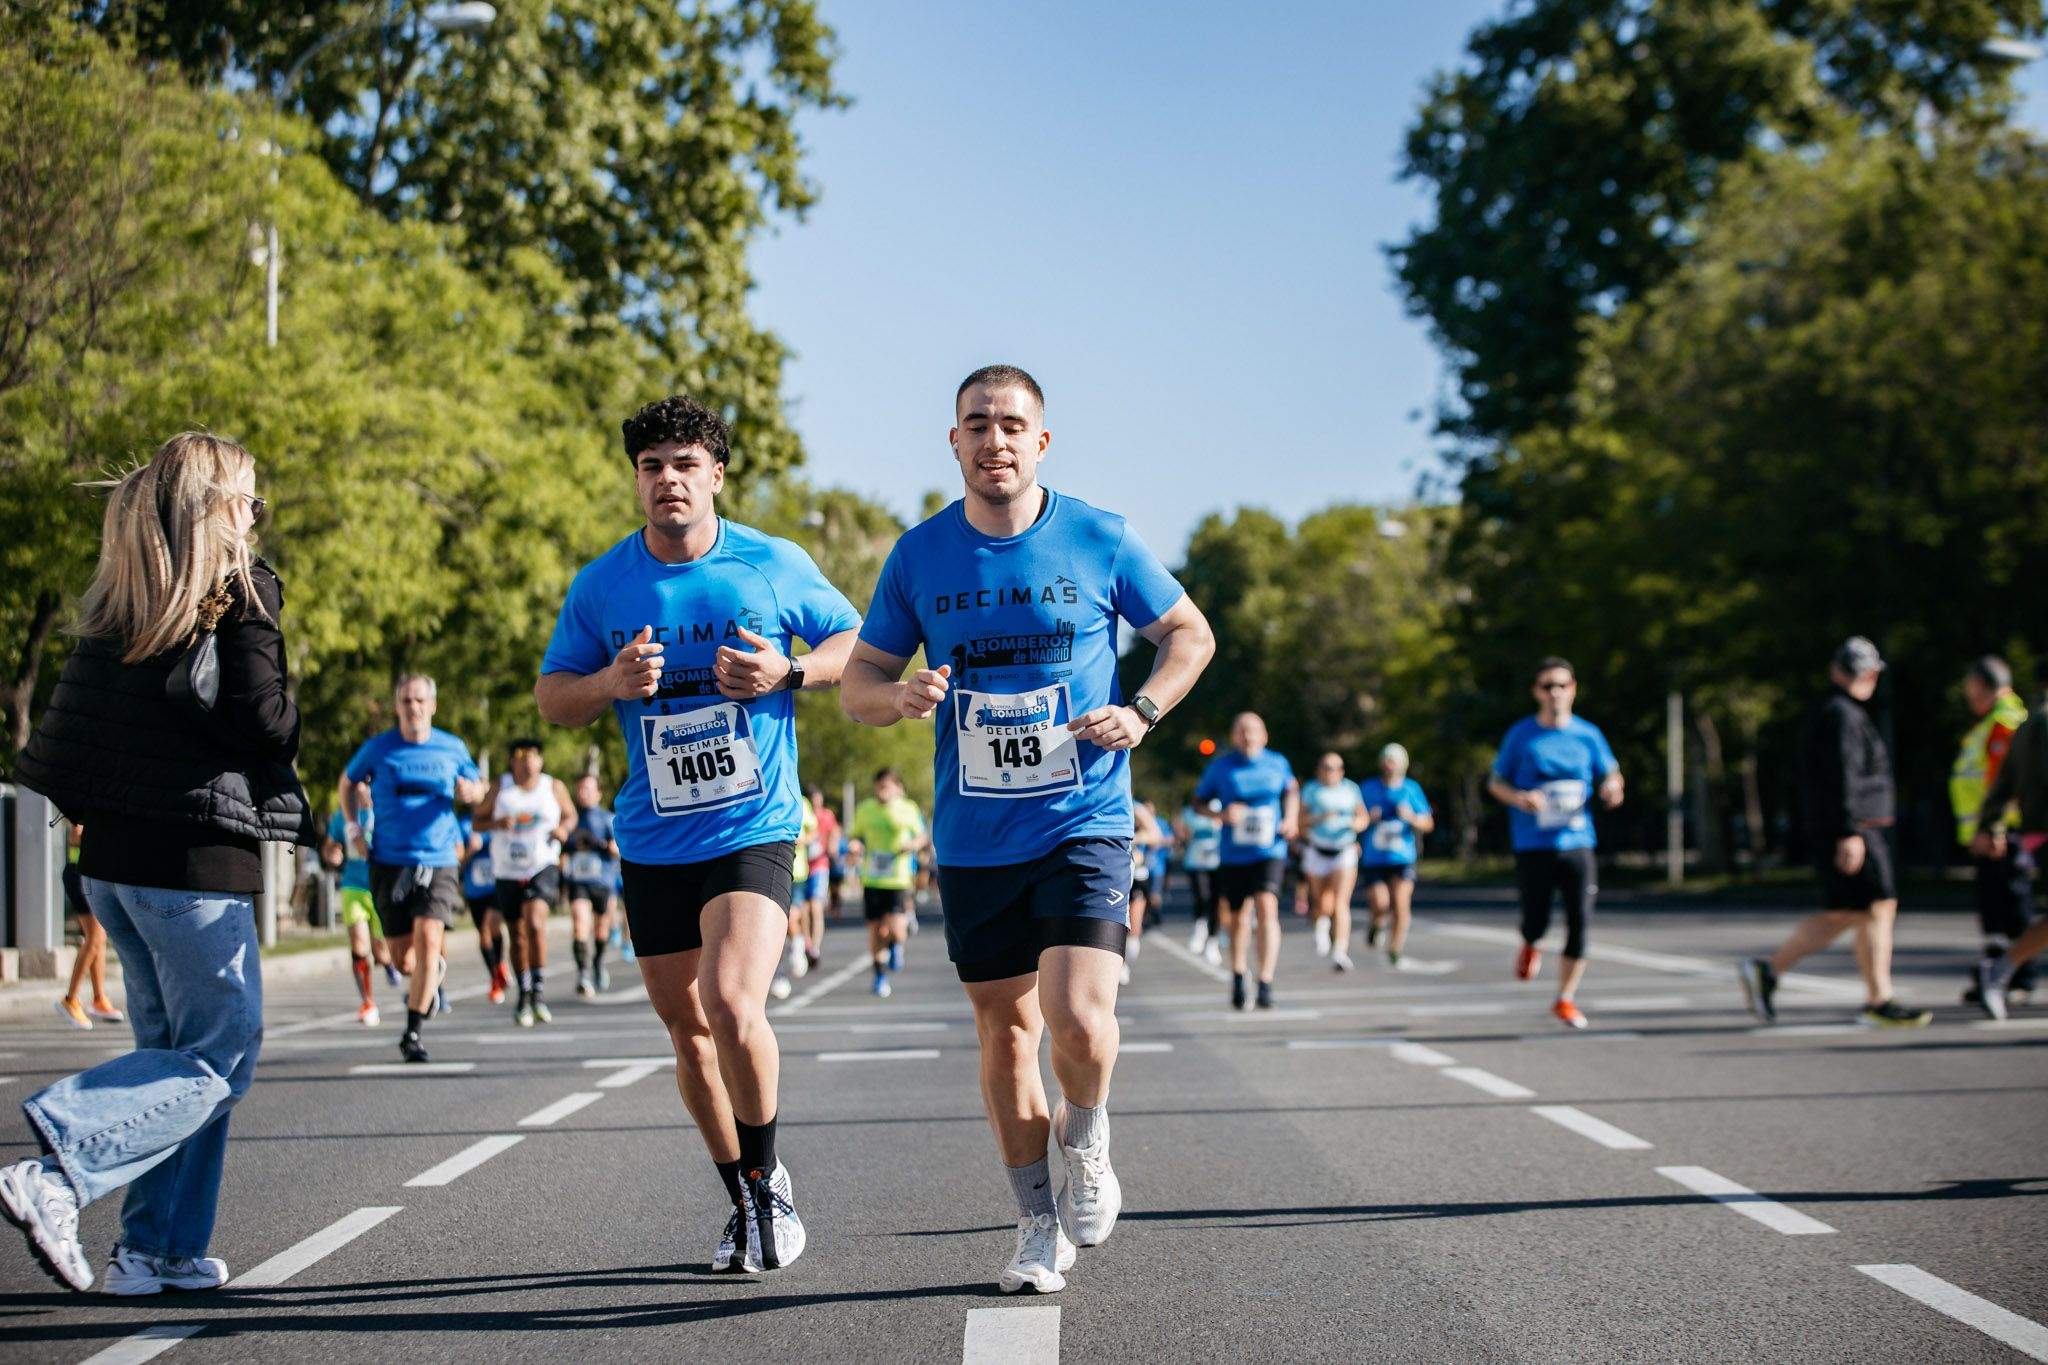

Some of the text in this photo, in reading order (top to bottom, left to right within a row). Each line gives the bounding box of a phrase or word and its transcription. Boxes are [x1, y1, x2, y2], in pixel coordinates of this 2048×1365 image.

[936, 586, 1078, 615] DECIMAS
[976, 635, 1071, 651] BOMBEROS
[1013, 647, 1070, 664] de MADRID
[991, 703, 1048, 718] BOMBEROS
[673, 719, 727, 738] BOMBEROS
[986, 721, 1048, 736] DECIMAS
[671, 736, 730, 755] DECIMAS
[988, 735, 1043, 769] 143
[666, 746, 736, 786] 1405
